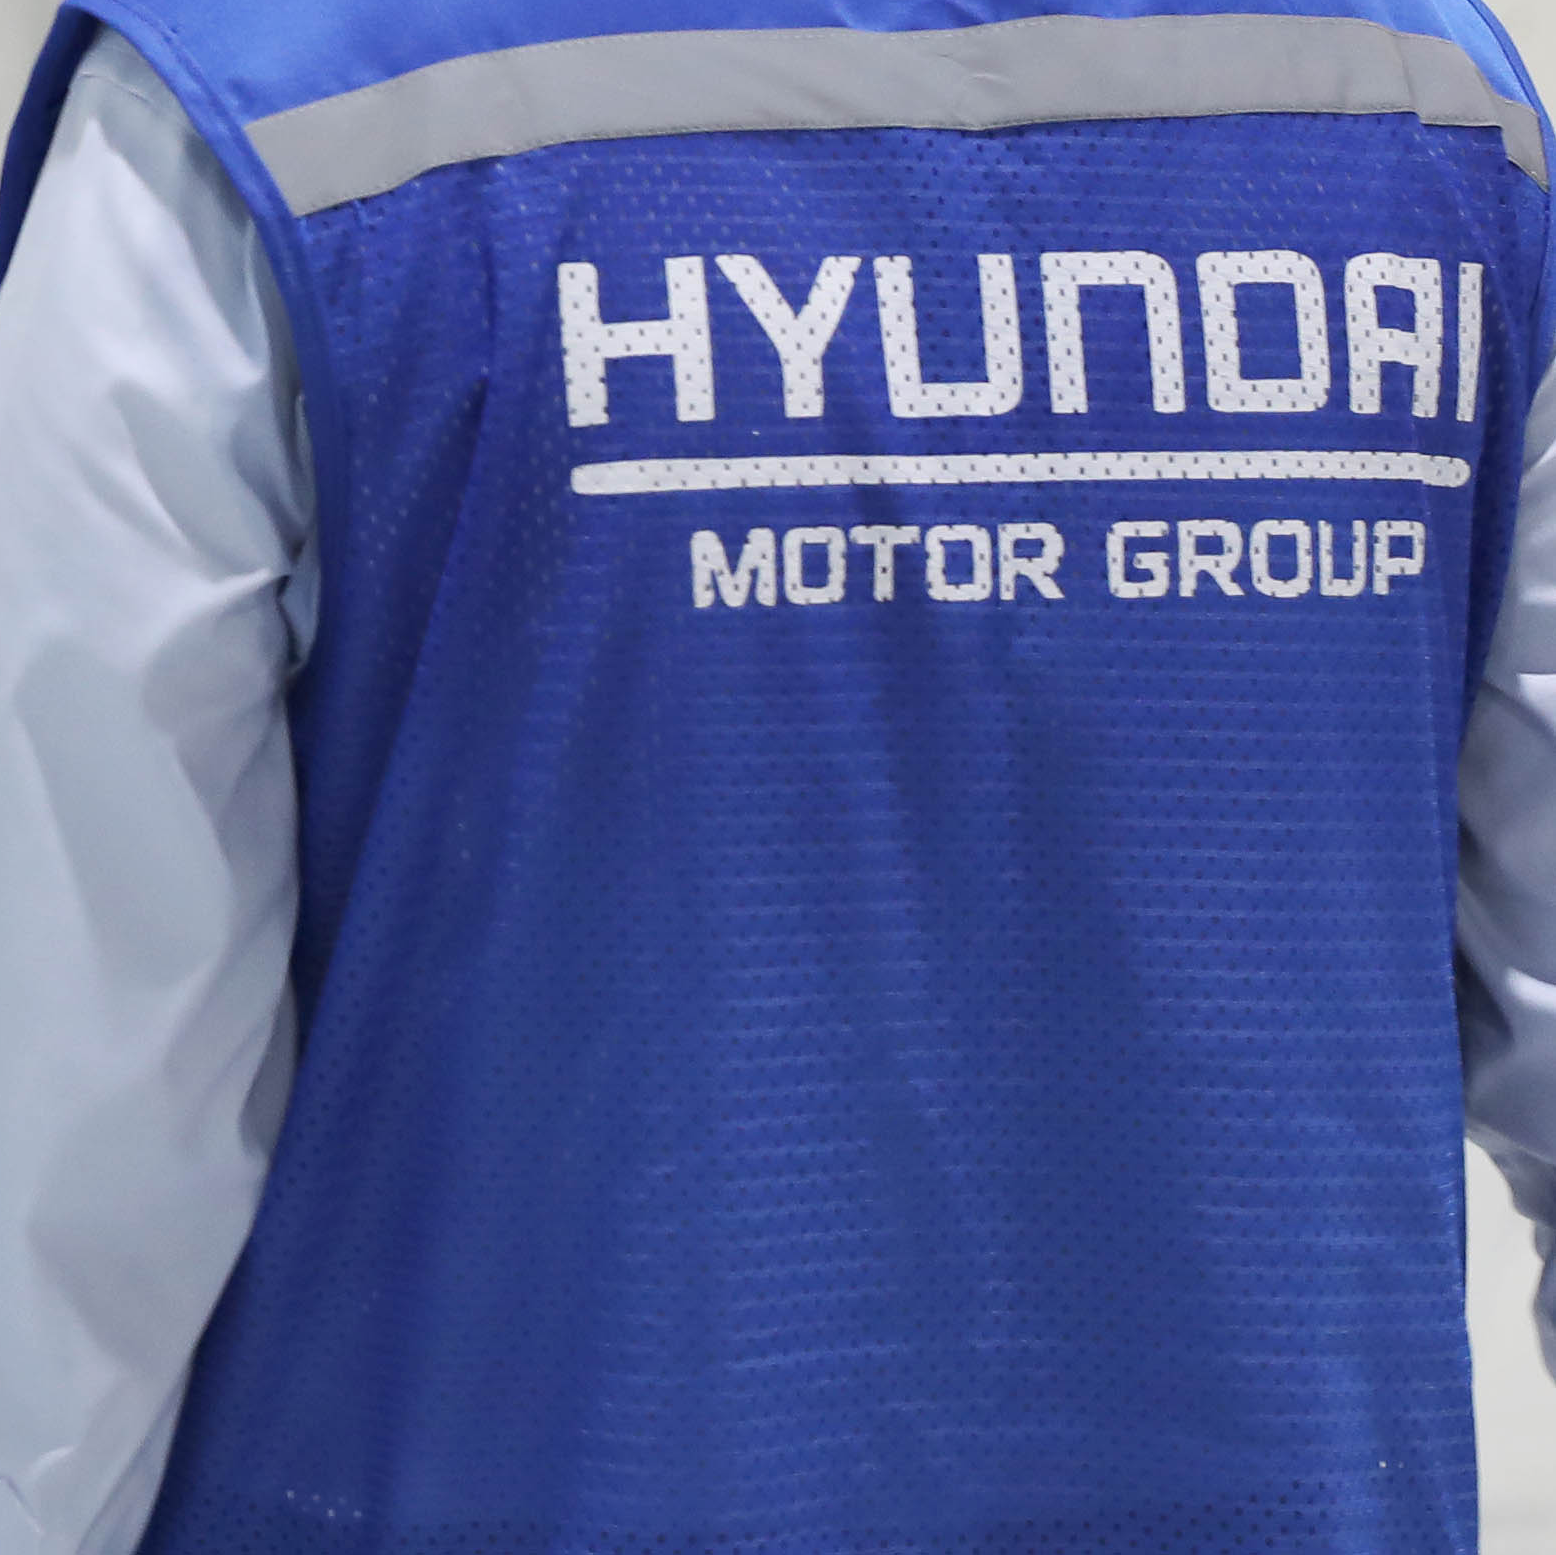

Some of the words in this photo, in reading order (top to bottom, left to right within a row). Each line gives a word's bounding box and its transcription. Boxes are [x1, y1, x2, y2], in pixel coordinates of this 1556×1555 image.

[557, 250, 1483, 426] HYUNDAI
[692, 525, 1066, 609] MOTOR
[1106, 519, 1426, 600] GROUP
